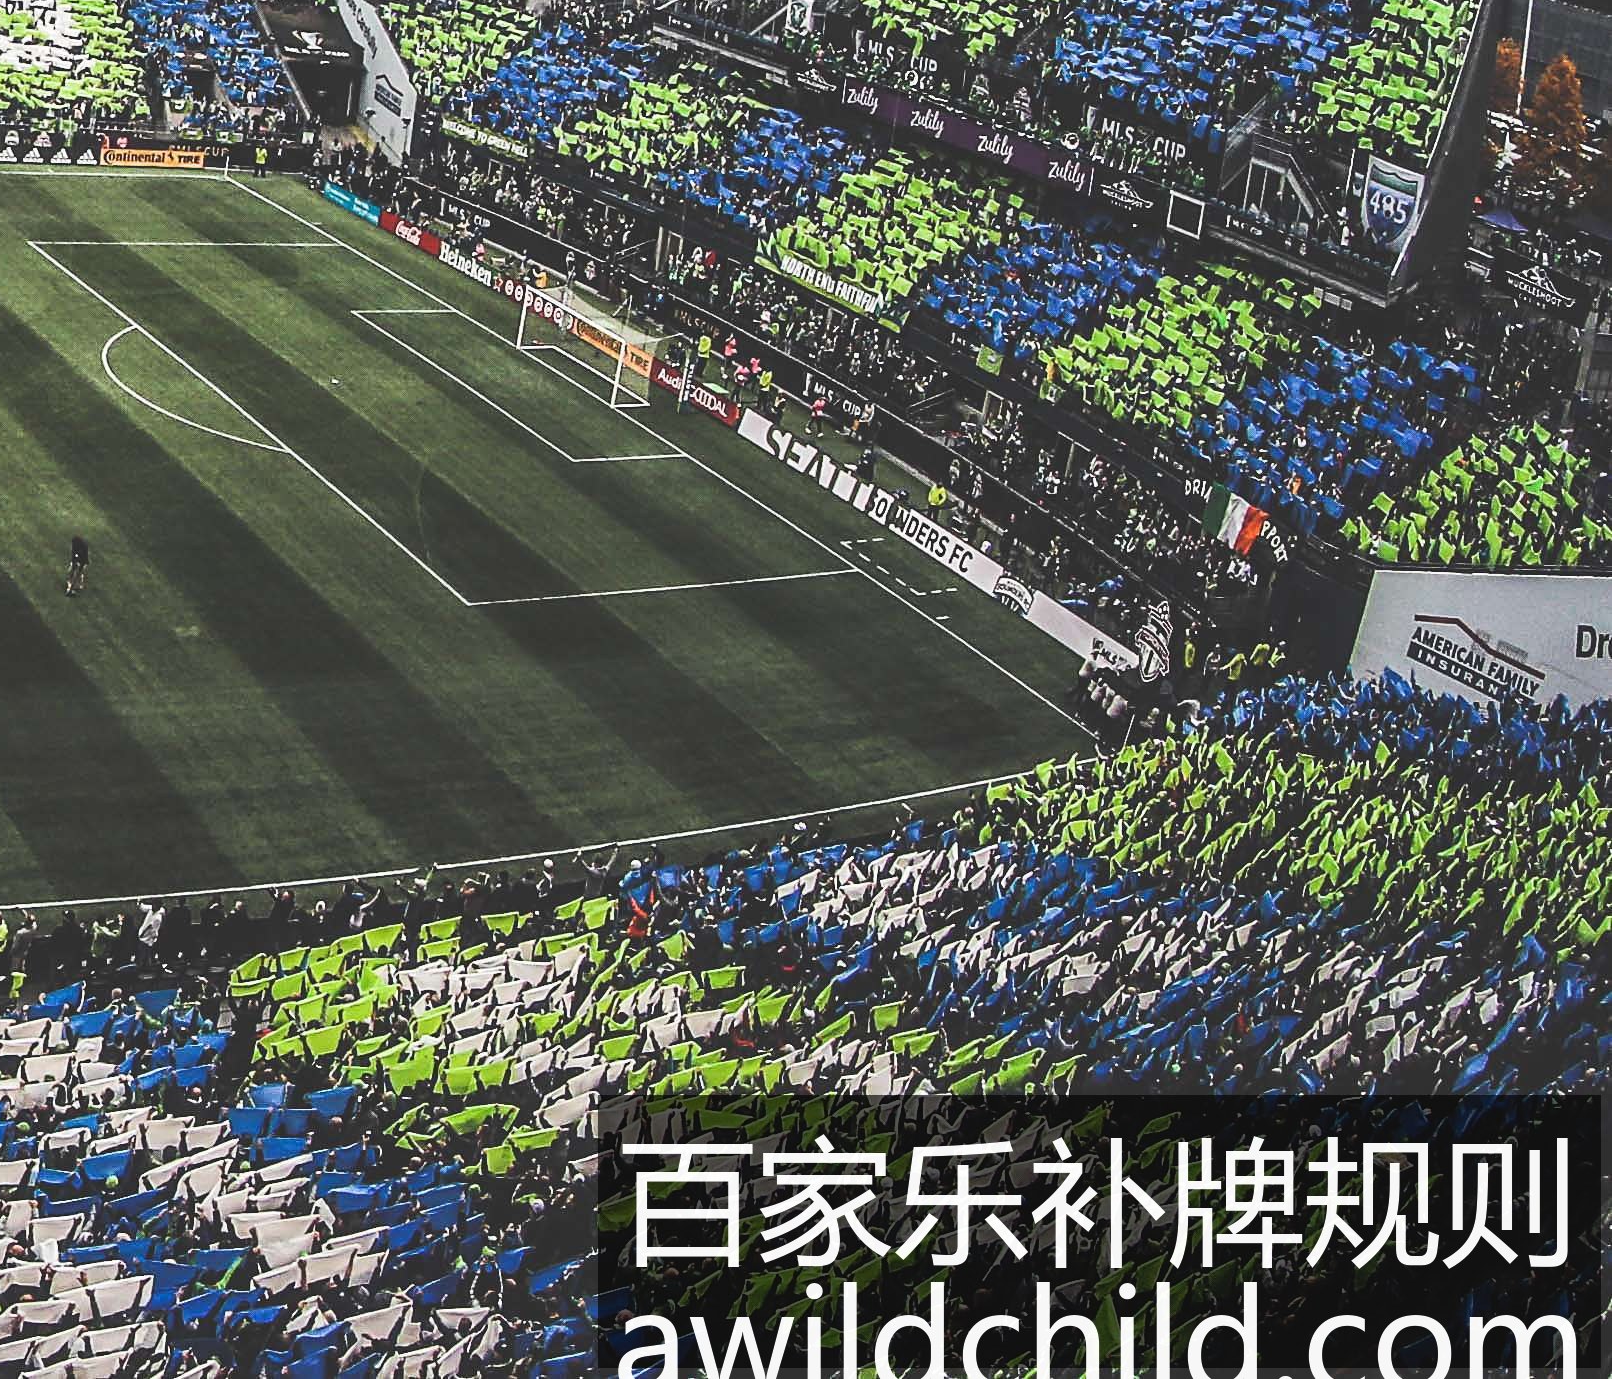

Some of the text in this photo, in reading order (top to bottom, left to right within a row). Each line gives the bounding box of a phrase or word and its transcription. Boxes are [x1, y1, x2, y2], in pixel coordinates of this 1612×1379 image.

[868, 38, 938, 75] MLS CUP
[104, 151, 201, 165] Continental TIRE
[1101, 117, 1187, 163] MLS CUP
[1369, 185, 1409, 226] 485
[439, 240, 492, 287] Heineken
[779, 254, 836, 293] NORTH END
[627, 350, 651, 373] TIRE
[657, 368, 683, 391] Audi
[842, 398, 863, 418] CUP
[947, 543, 975, 575] FC
[1411, 625, 1542, 700] AMERICAN FAMILY
